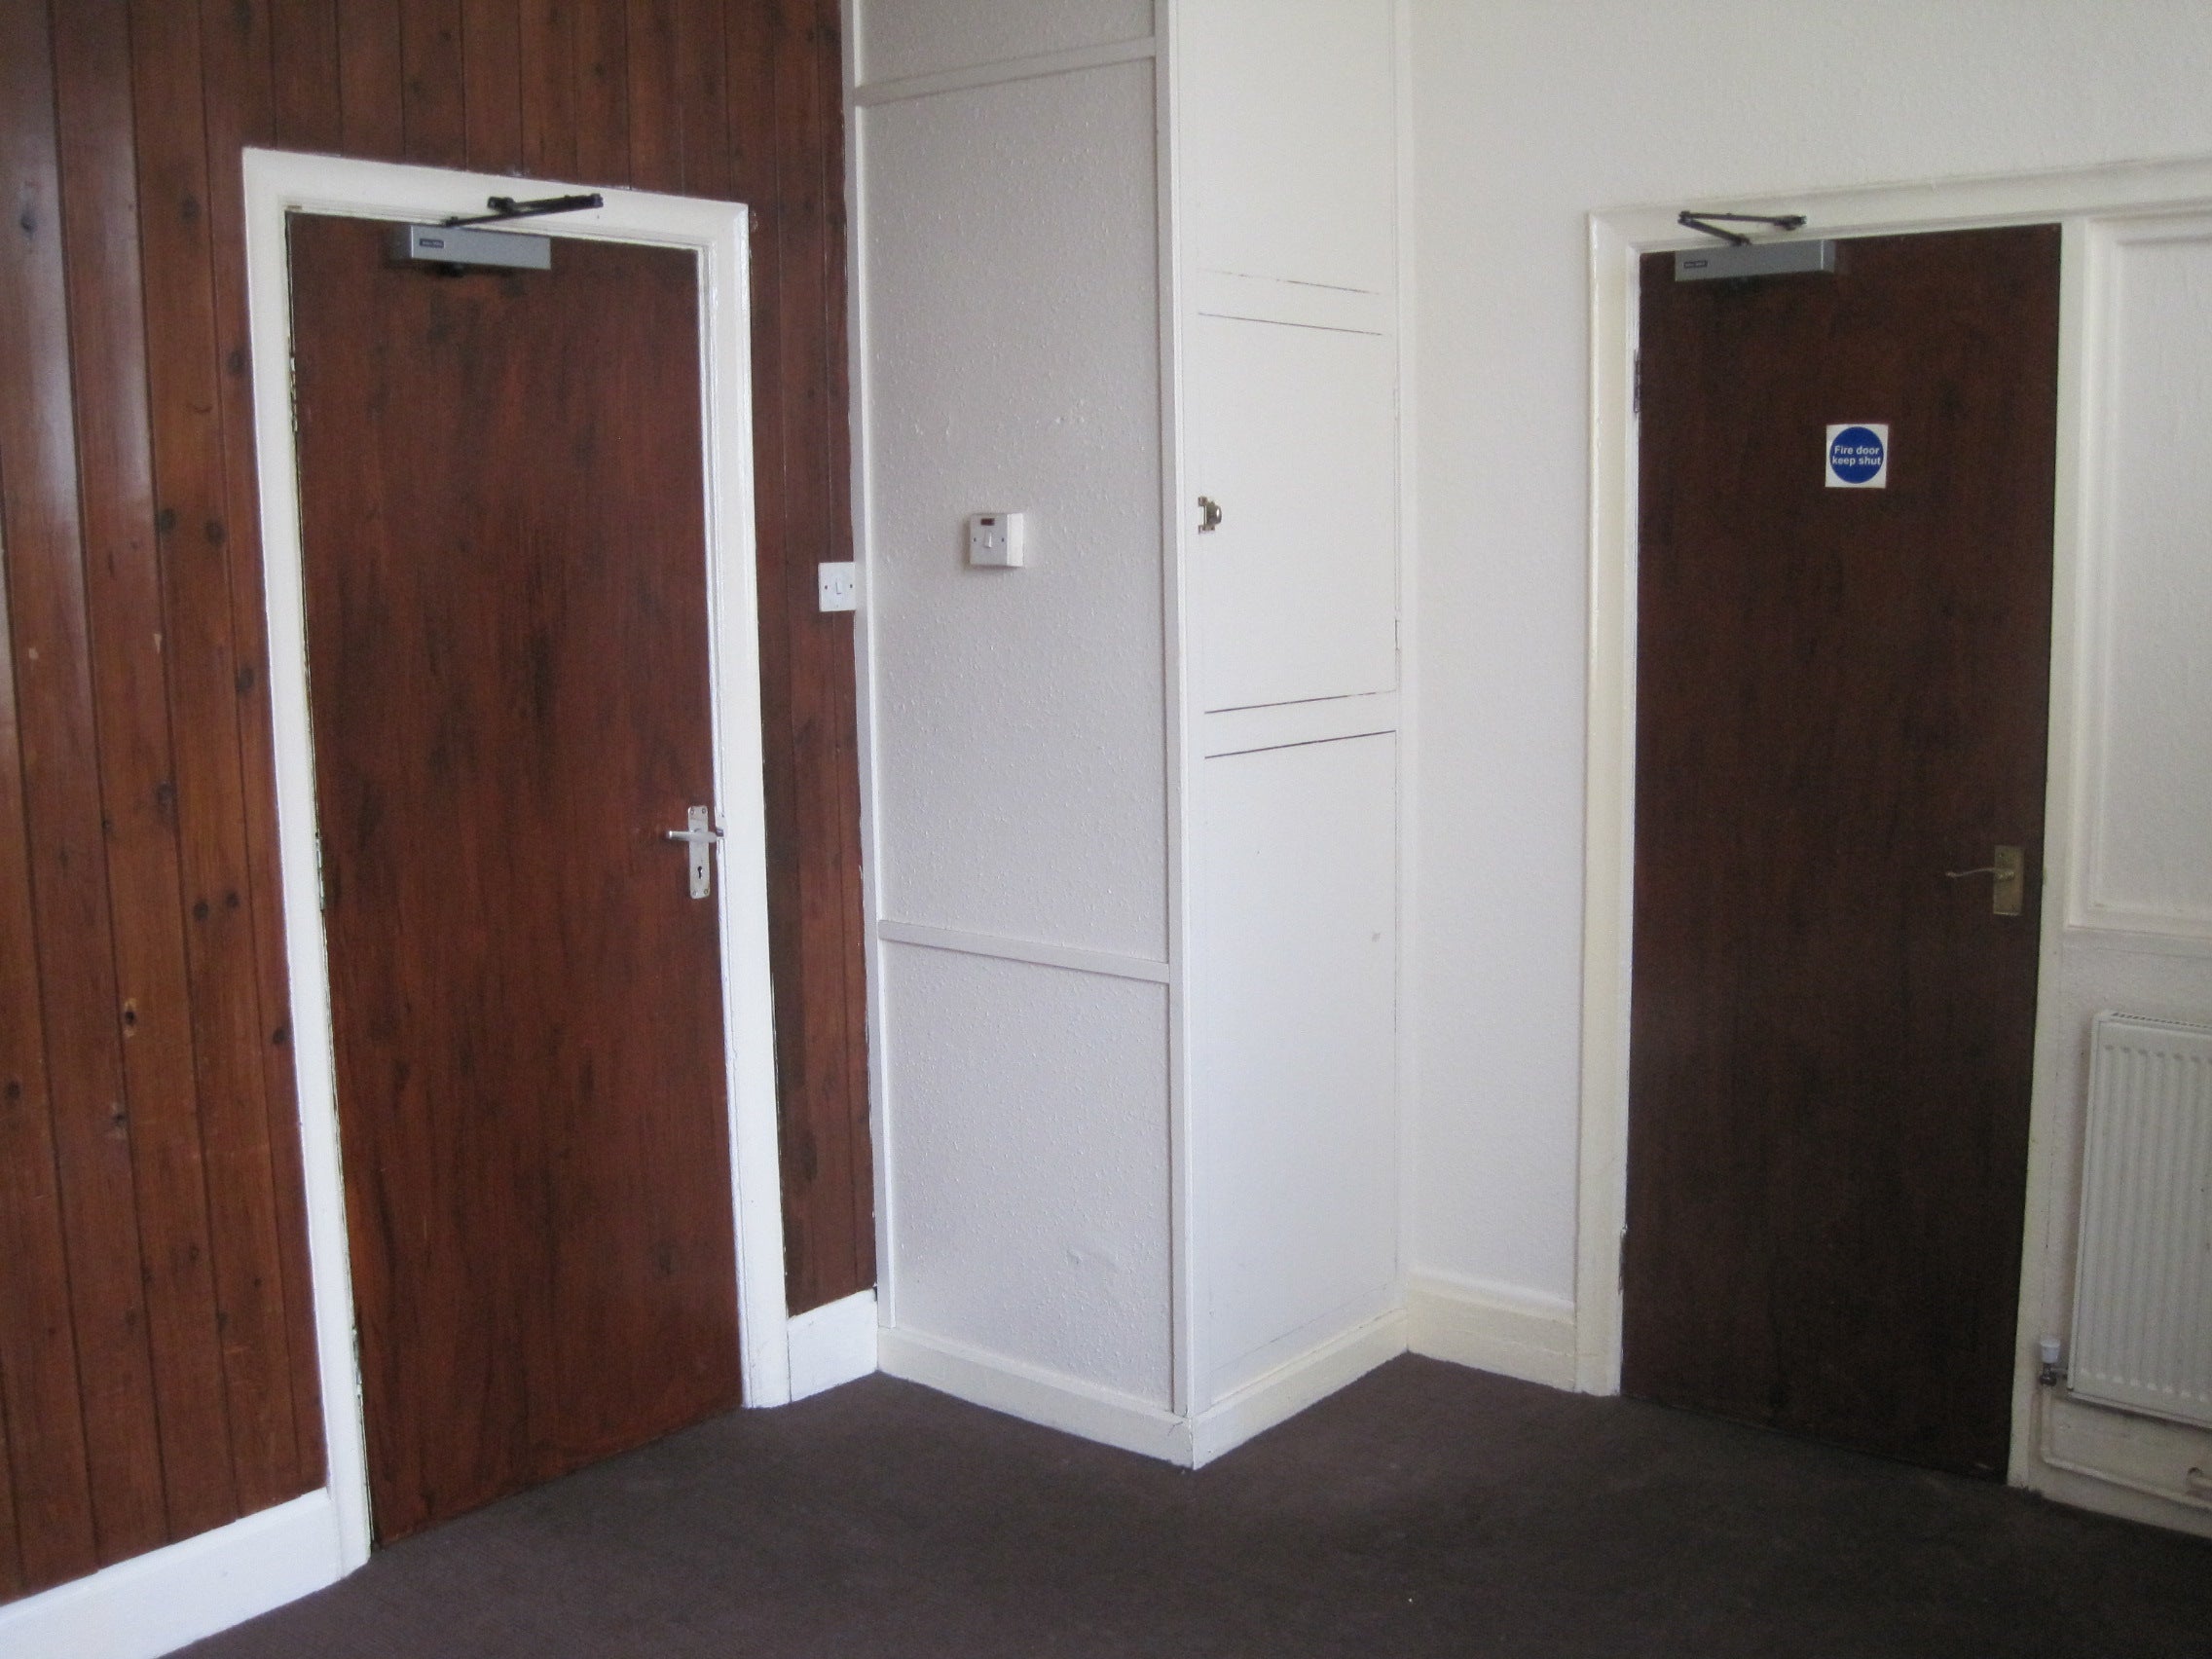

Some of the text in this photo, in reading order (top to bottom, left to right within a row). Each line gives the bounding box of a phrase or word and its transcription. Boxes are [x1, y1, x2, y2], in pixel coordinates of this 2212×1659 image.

[1834, 445, 1880, 455] Fire door
[1832, 456, 1881, 466] keep shut
